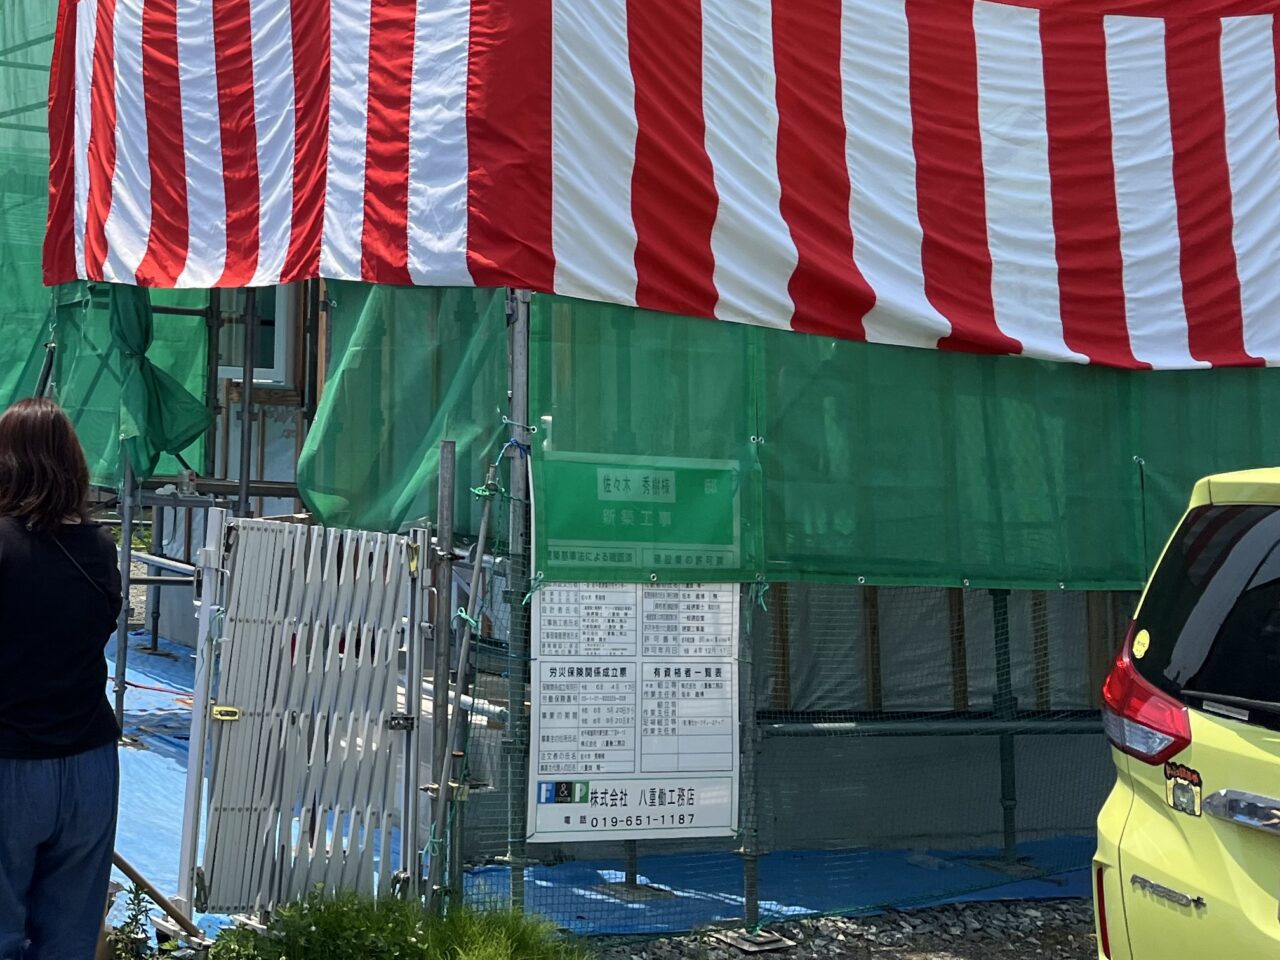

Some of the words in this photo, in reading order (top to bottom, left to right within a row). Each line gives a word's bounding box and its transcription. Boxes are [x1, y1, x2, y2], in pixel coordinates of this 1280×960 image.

[603, 474, 632, 496] 佐々木
[602, 508, 672, 528] 新築工事
[549, 667, 627, 678] 労災保険関係成立票
[654, 667, 722, 678] 有資格者一覧表
[590, 788, 628, 808] 株式会社
[591, 813, 696, 828] 019-651-1187
